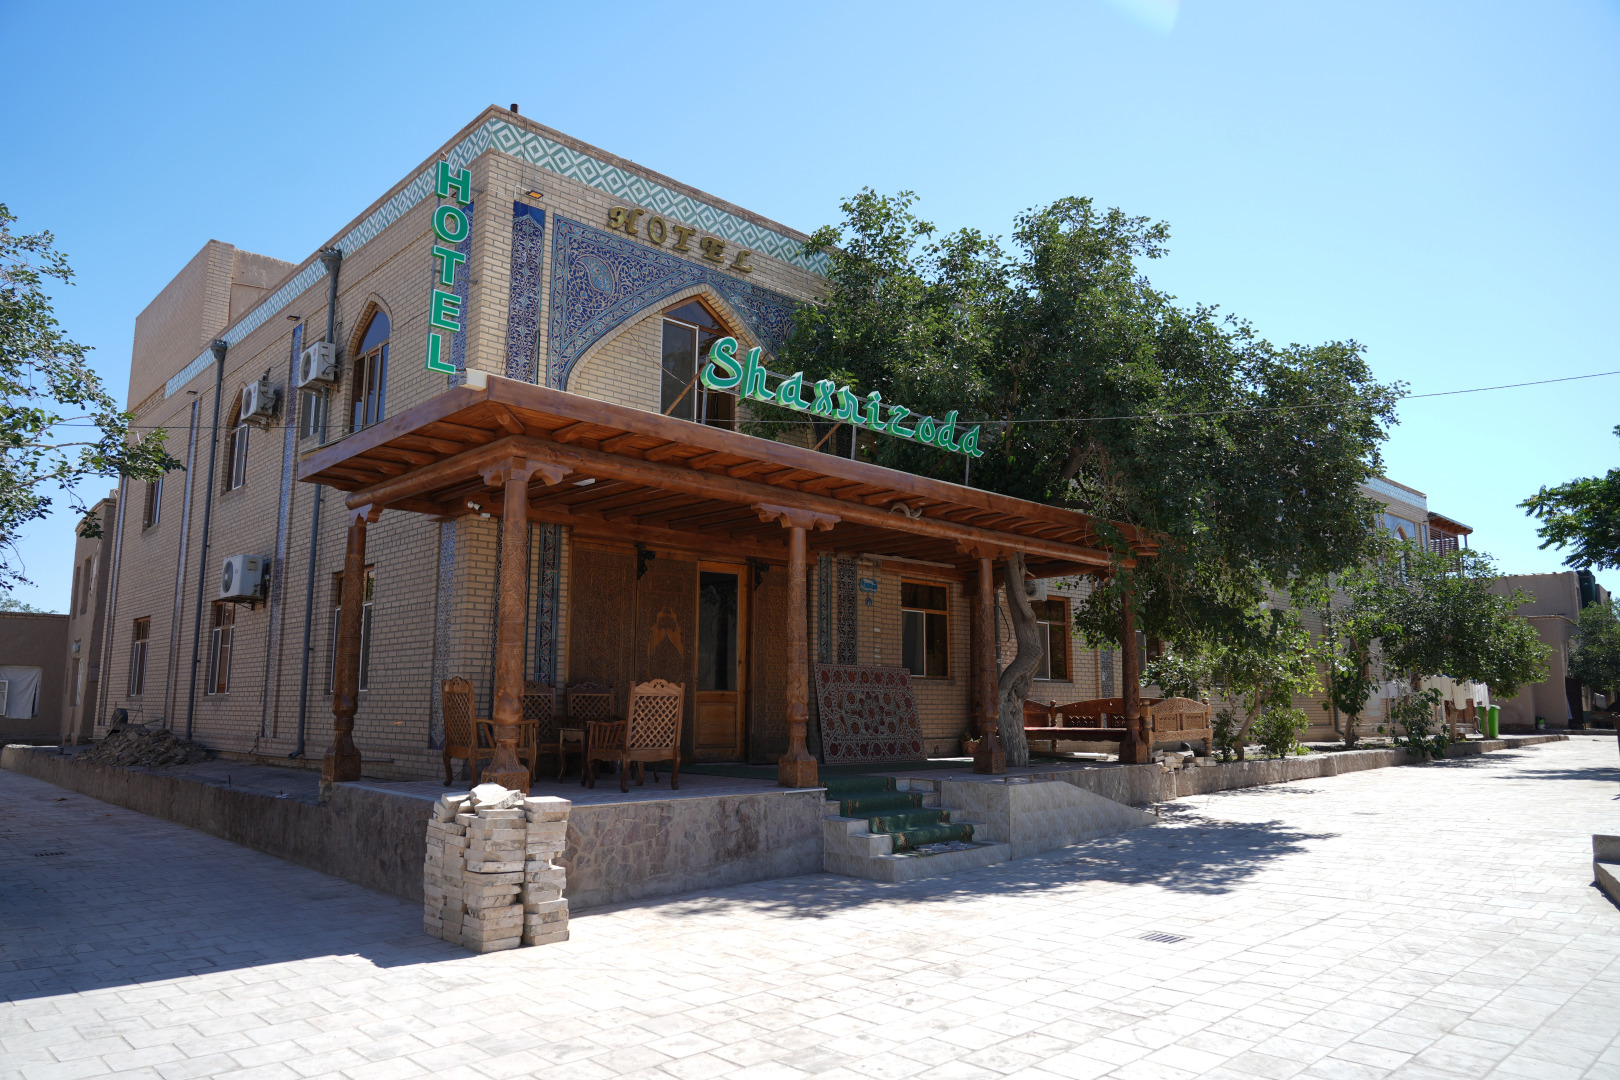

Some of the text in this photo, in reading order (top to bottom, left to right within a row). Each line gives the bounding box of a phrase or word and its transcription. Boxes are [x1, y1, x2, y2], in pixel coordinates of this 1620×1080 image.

[426, 160, 472, 375] HOTEL
[608, 205, 753, 273] HOTEL
[700, 336, 984, 458] Shaxrizoda
